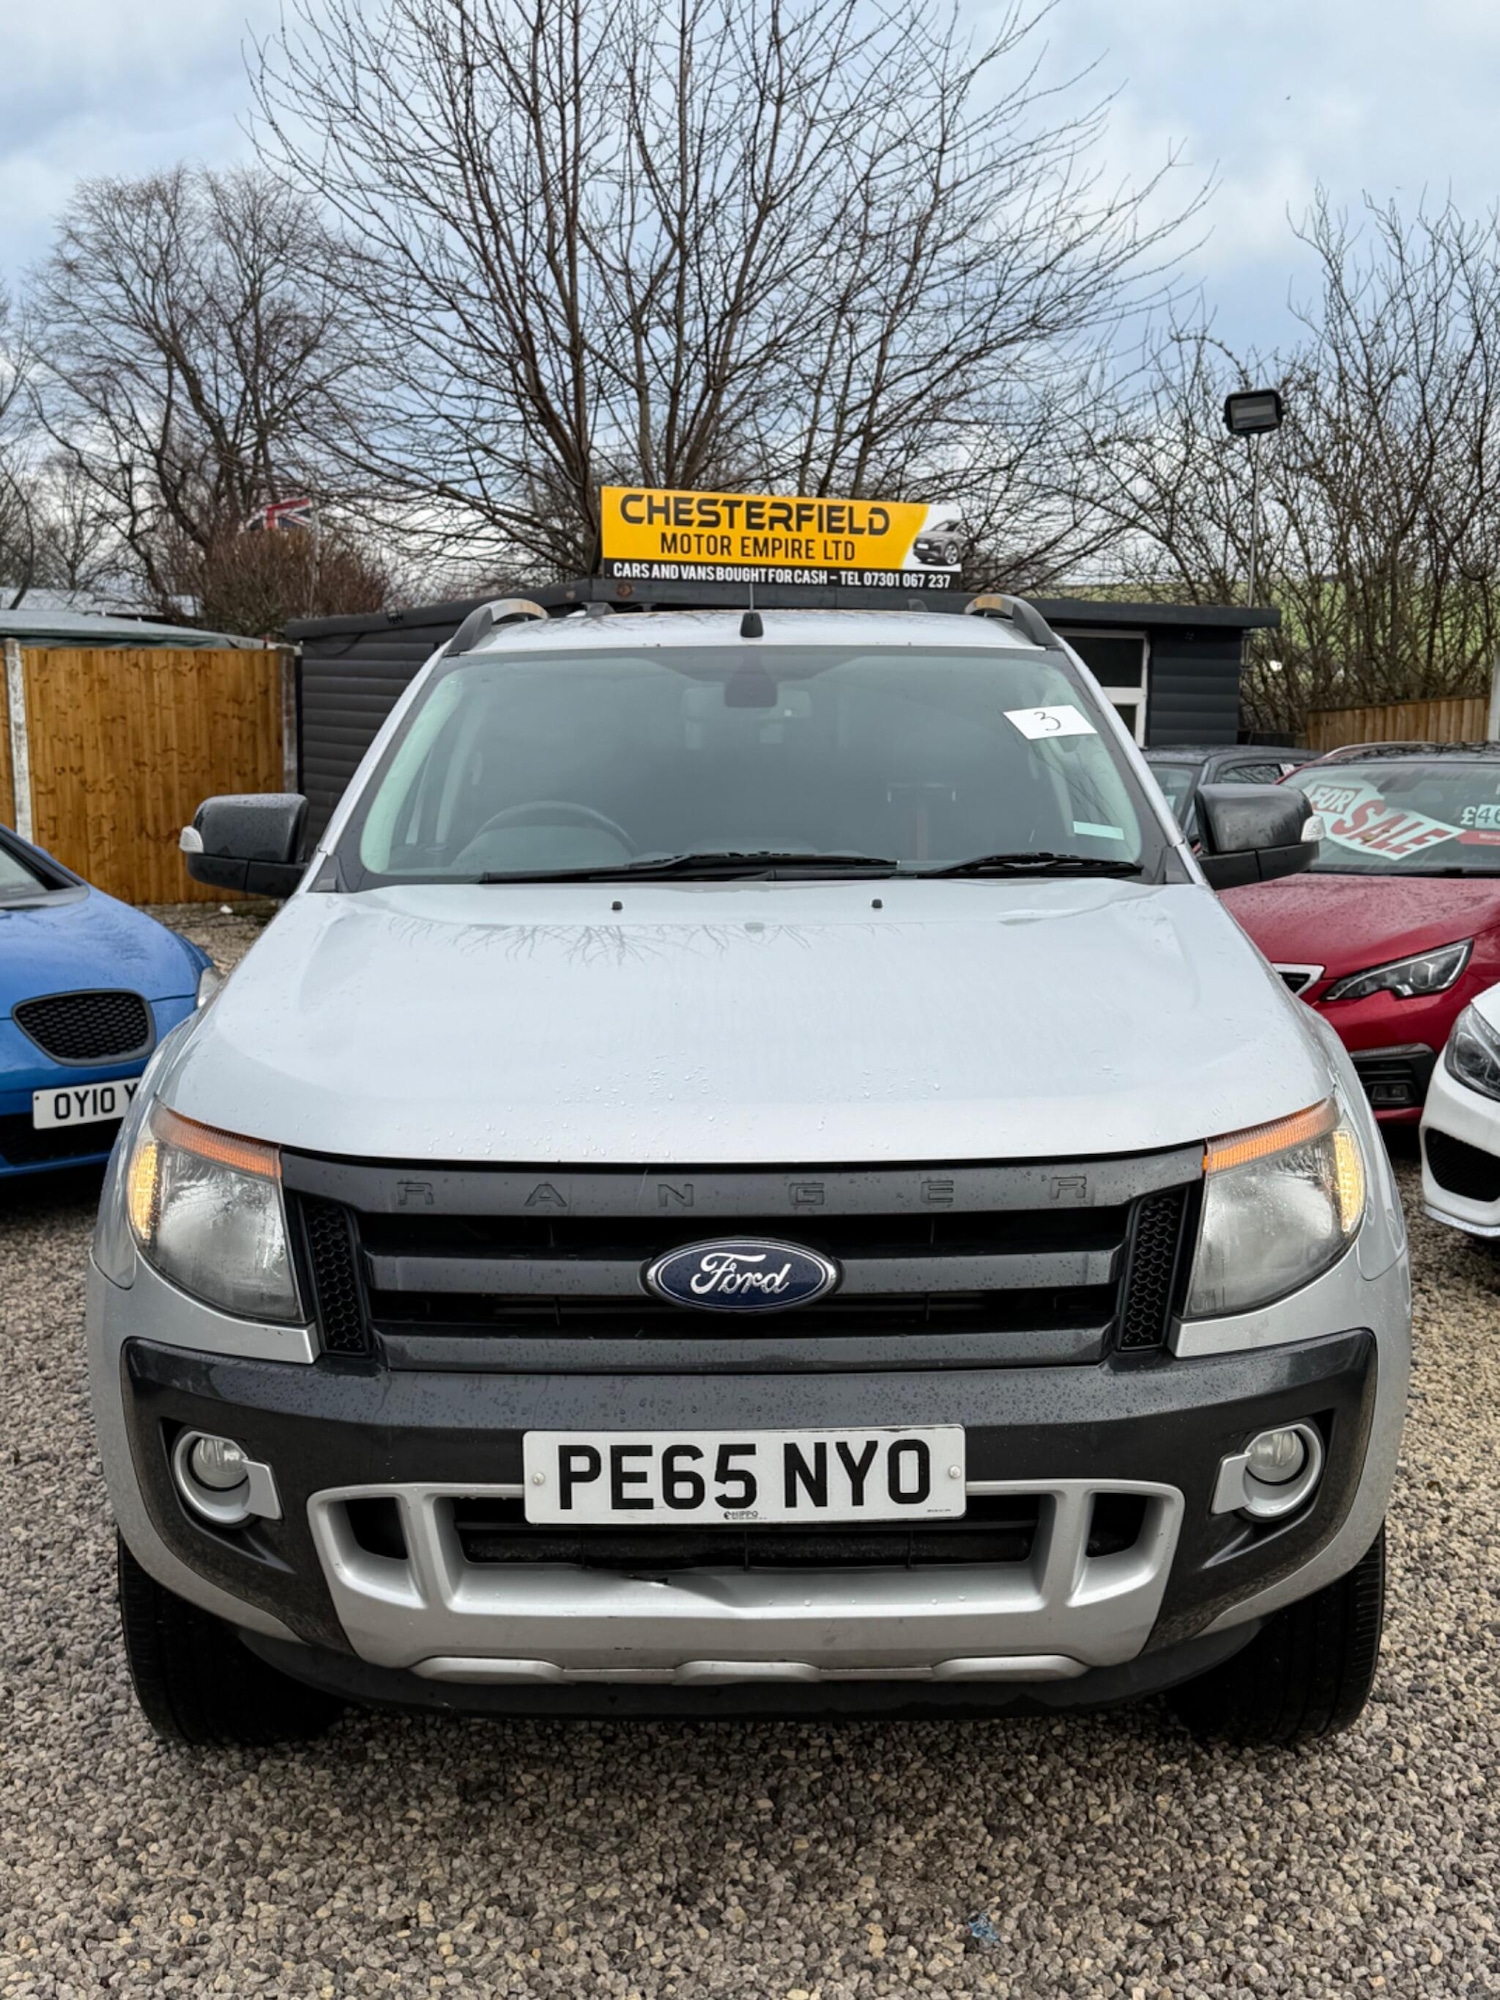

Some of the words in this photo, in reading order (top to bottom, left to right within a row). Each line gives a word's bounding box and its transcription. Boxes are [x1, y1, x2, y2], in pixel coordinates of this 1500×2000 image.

[620, 494, 890, 536] CHESTERFIELD
[660, 532, 732, 556] MOTOR
[741, 536, 816, 560] EMPIRE
[823, 539, 855, 561] LTD
[613, 562, 650, 578] CARS
[651, 563, 679, 579] AND
[680, 564, 715, 581] VANS
[716, 566, 767, 582] BOUGHT
[768, 568, 793, 583] FOR
[794, 569, 828, 585] CASH
[839, 571, 862, 586] TEL
[863, 572, 900, 588] 07301
[902, 573, 925, 588] 067
[928, 574, 951, 588] 237
[1034, 711, 1061, 731] 3
[1309, 787, 1353, 813] FOR
[1331, 800, 1454, 854] SALE
[397, 1175, 1091, 1208] RANGER
[690, 1252, 790, 1296] Ford
[557, 1443, 758, 1510] PE65
[783, 1439, 931, 1507] NYO
